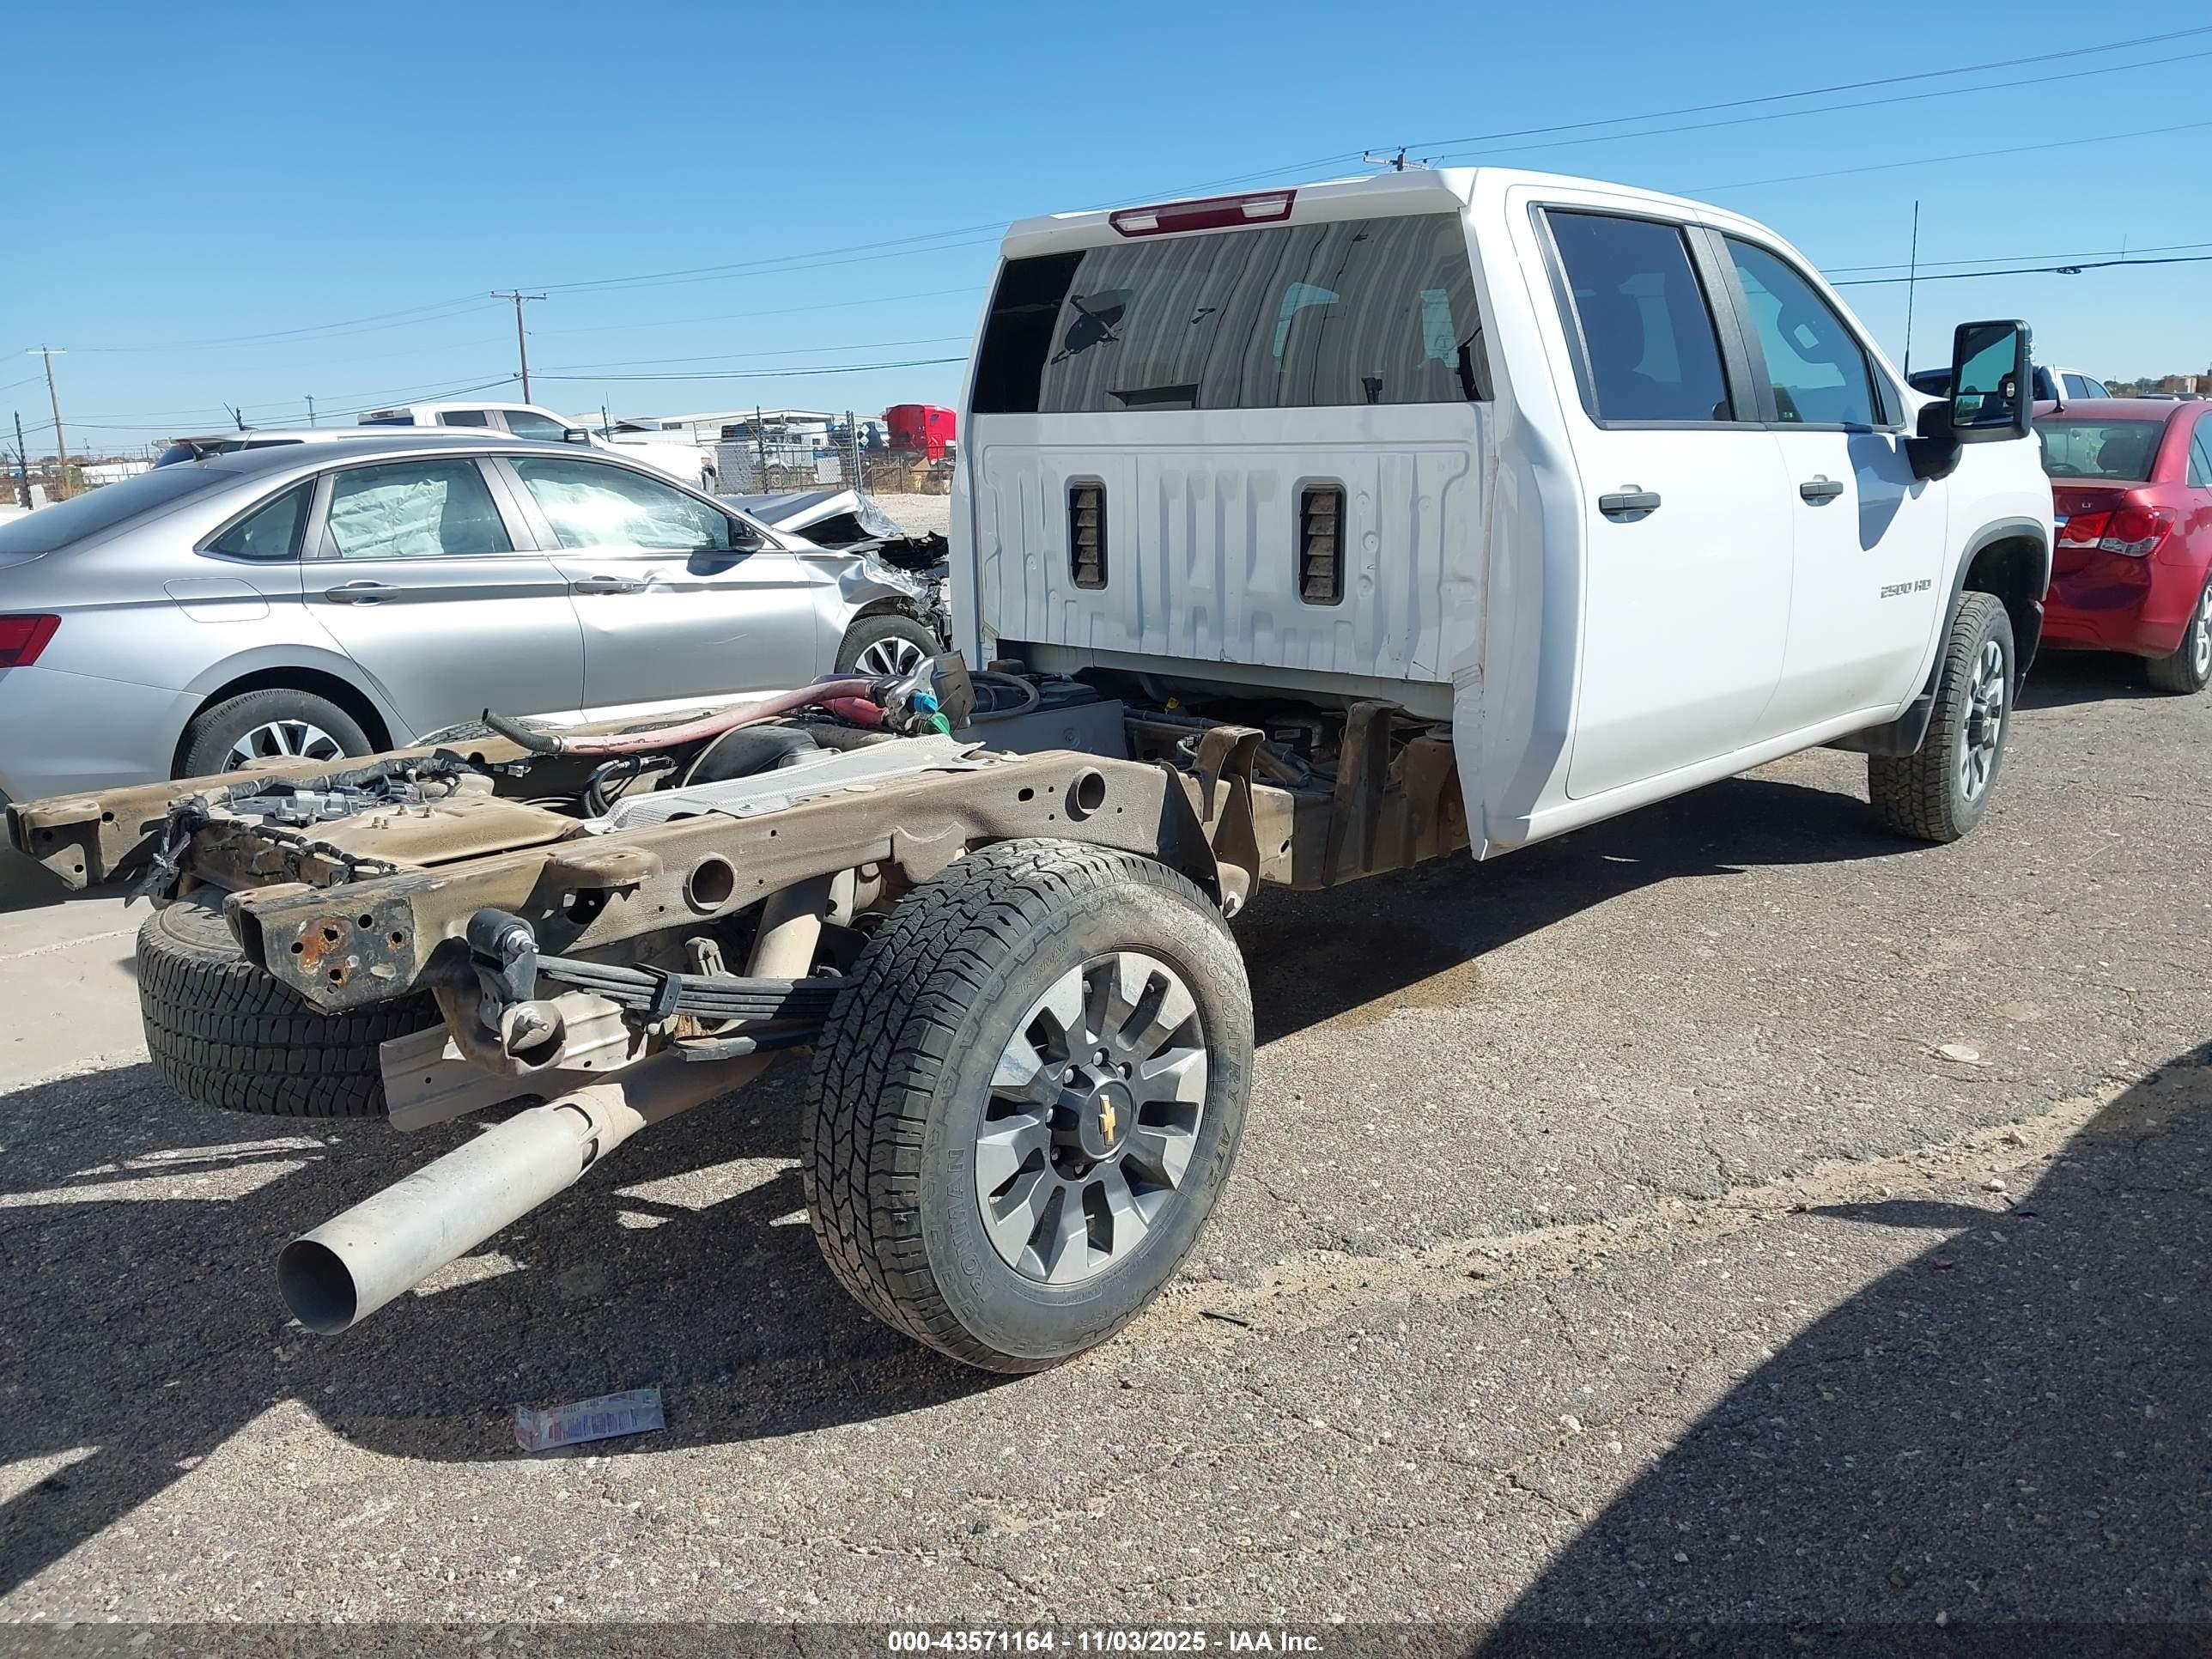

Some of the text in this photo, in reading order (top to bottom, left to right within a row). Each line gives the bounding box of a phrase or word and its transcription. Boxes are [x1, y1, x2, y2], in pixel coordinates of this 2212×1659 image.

[1881, 579, 1931, 599] 2500 HD
[1206, 957, 1243, 1108] COUNTRY
